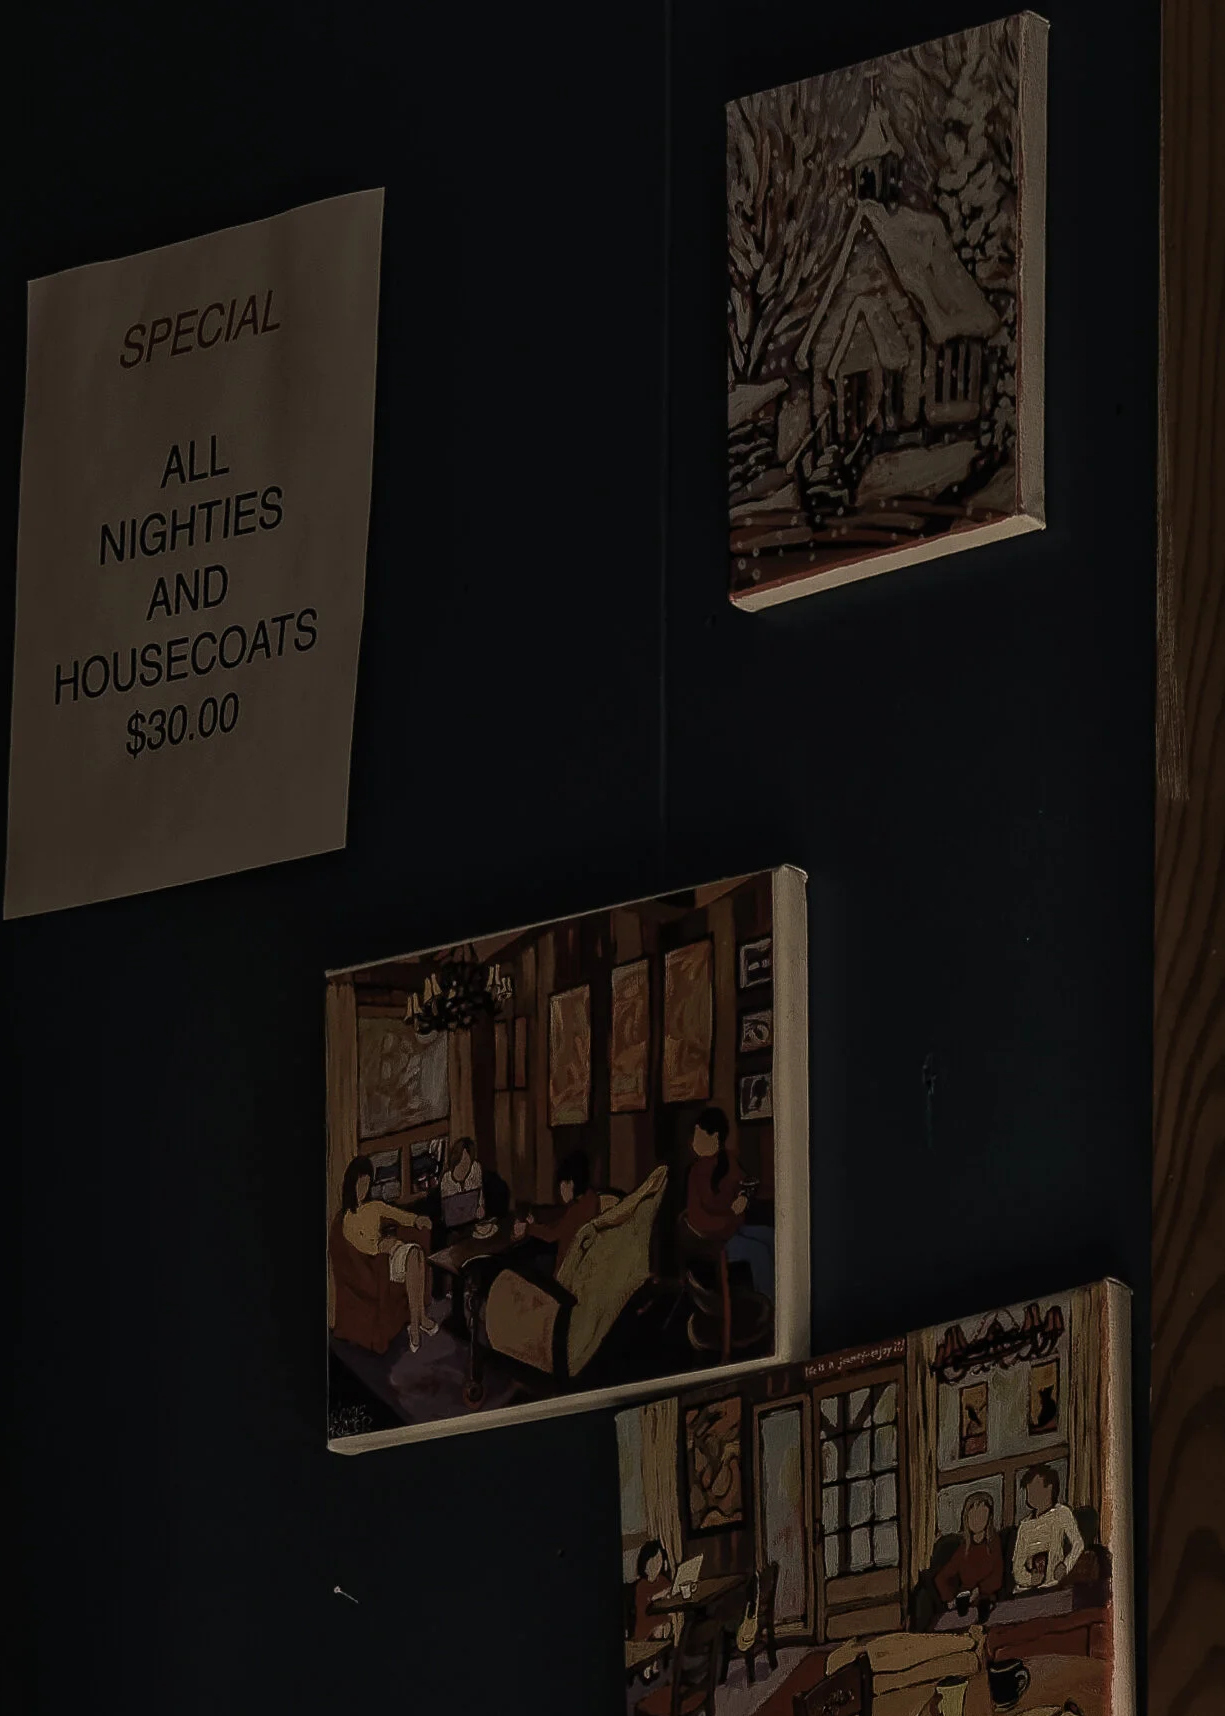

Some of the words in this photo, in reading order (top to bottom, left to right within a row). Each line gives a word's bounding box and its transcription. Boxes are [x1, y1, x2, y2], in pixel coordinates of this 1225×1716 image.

[119, 289, 281, 369] SPECIAL
[159, 434, 230, 489] ALL
[99, 485, 283, 566] NIGHTIES
[145, 564, 229, 621] AND
[54, 607, 318, 706] HOUSECOATS
[125, 692, 240, 760] $30.00
